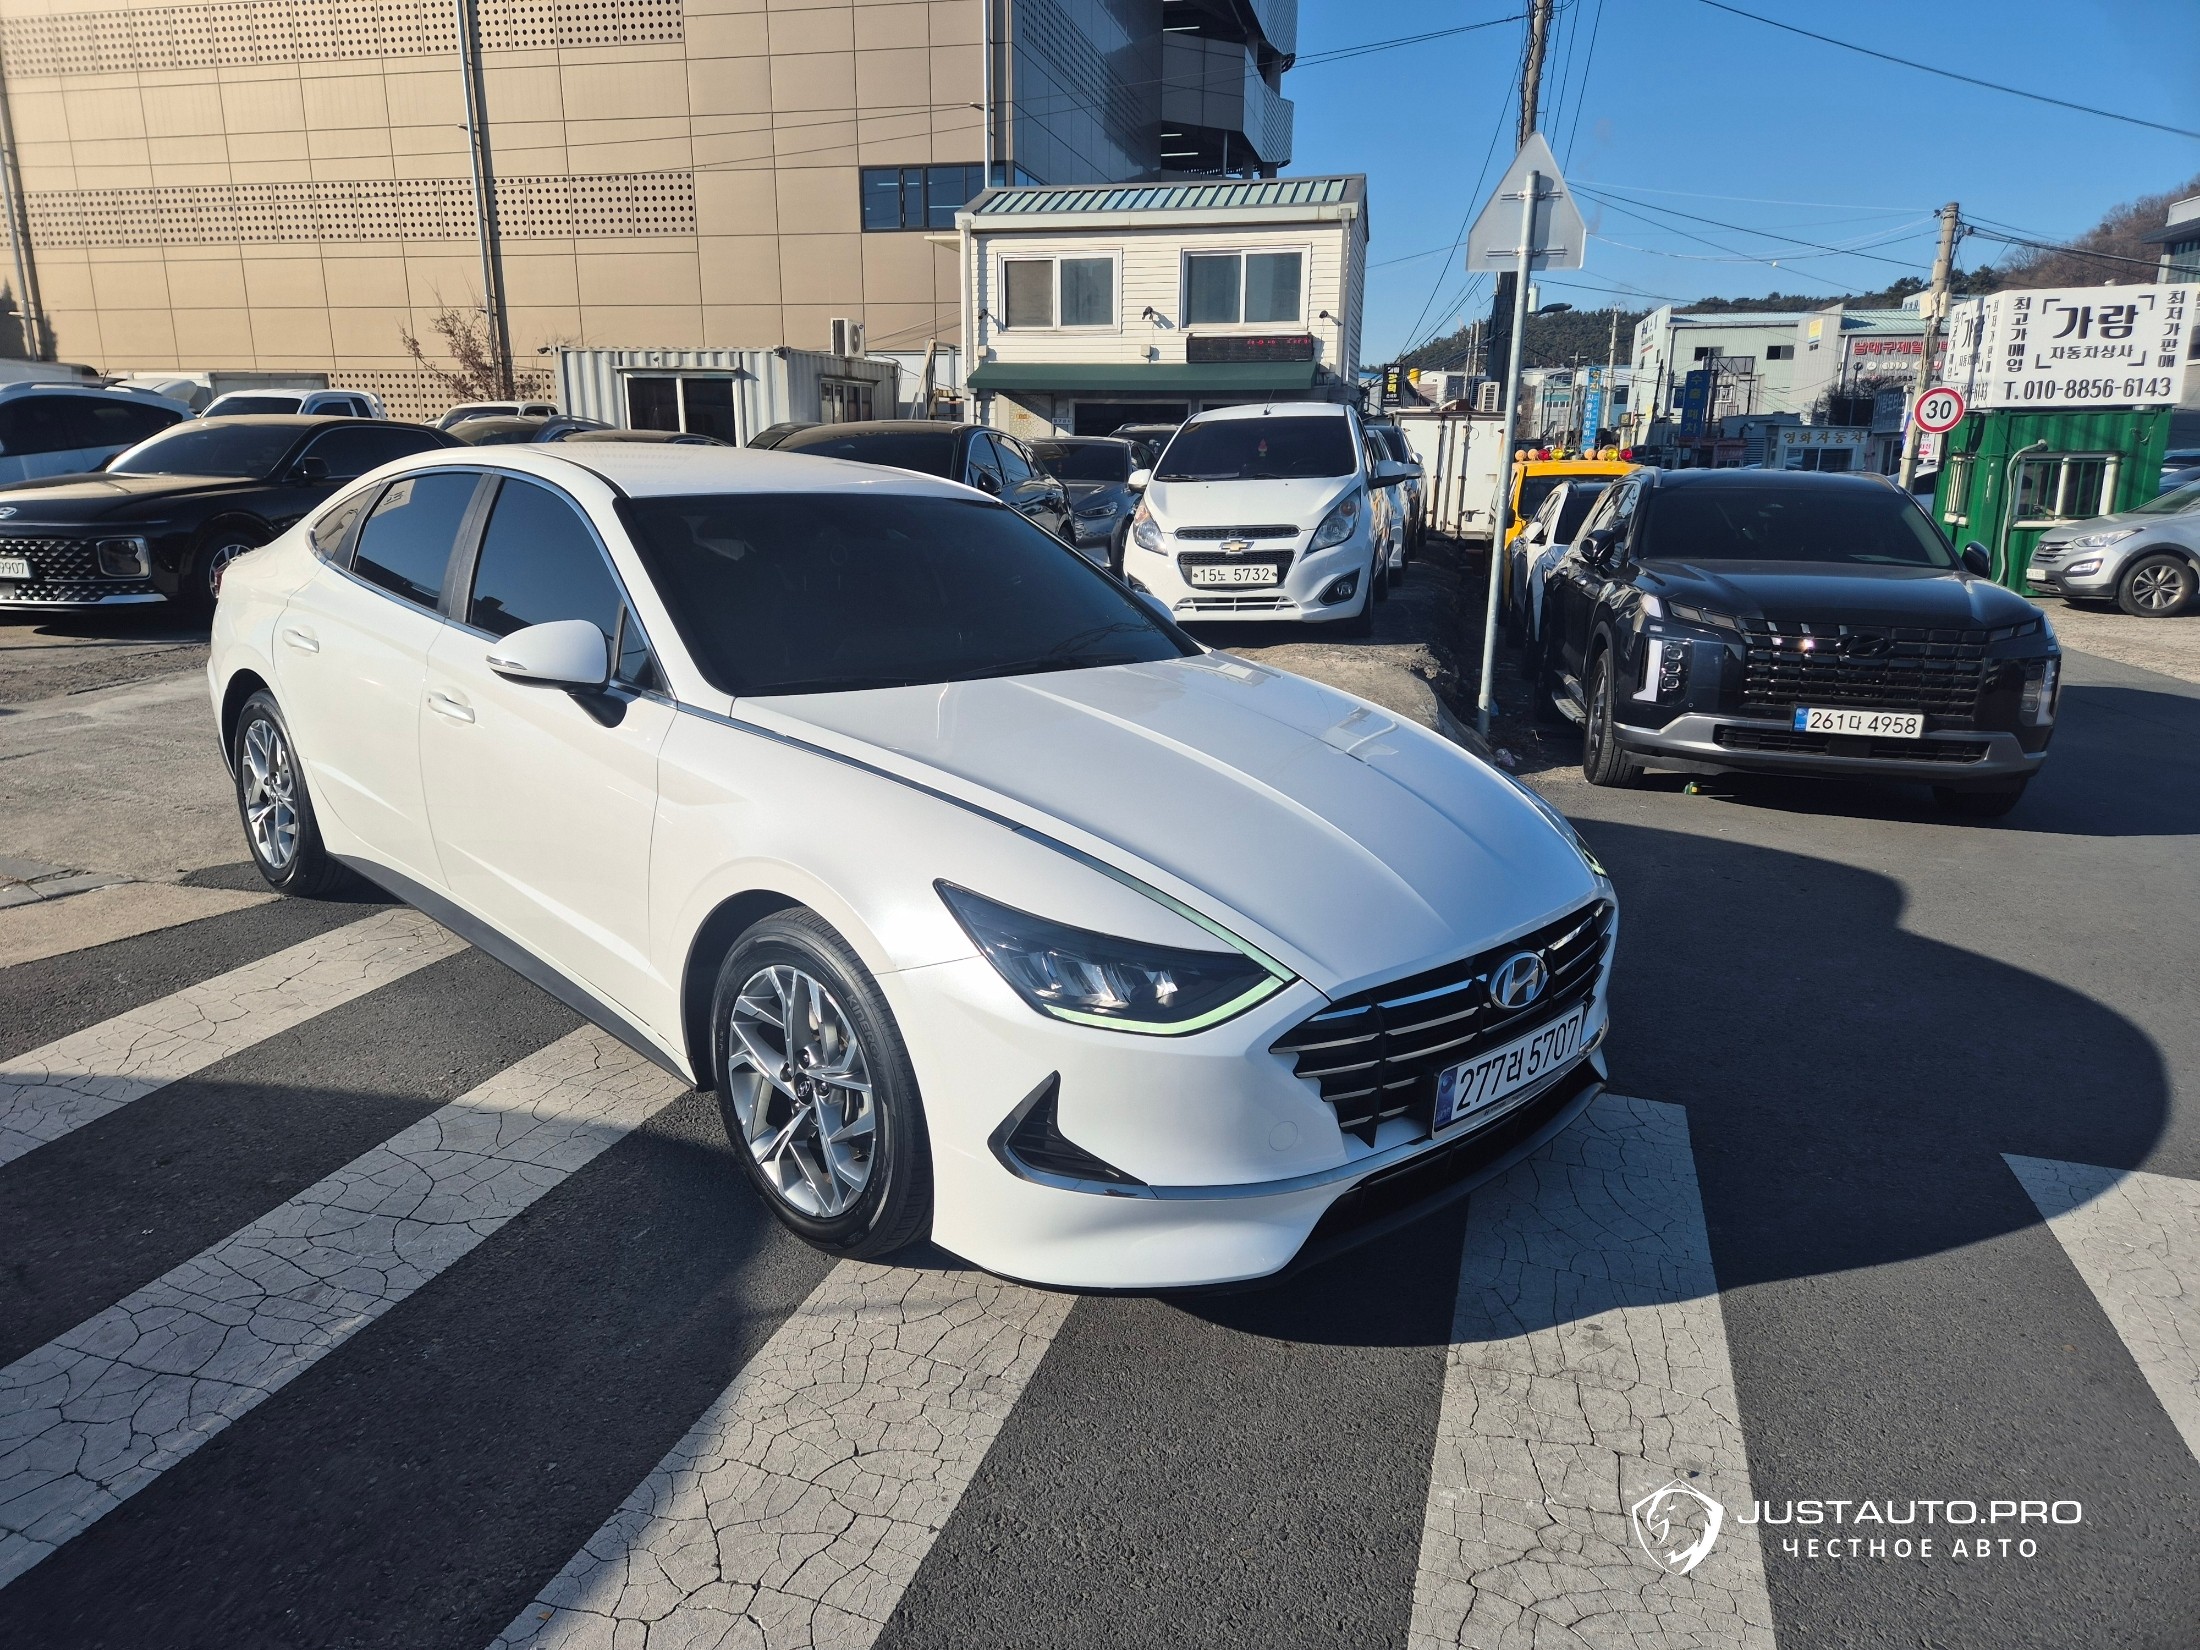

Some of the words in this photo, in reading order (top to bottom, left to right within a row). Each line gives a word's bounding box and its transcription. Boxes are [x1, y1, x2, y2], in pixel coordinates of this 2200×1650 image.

[2052, 303, 2139, 340] 가람
[2158, 290, 2186, 368] 최저가판매
[2006, 296, 2031, 372] 최고가매입
[2049, 344, 2133, 360] 자동차상사
[2003, 377, 2171, 400] T.010-8856-6143
[1926, 400, 1952, 420] 30
[1200, 568, 1226, 581] 15노
[1234, 567, 1269, 581] 5732
[1867, 716, 1918, 734] 4958
[1527, 1014, 1579, 1076] 5707
